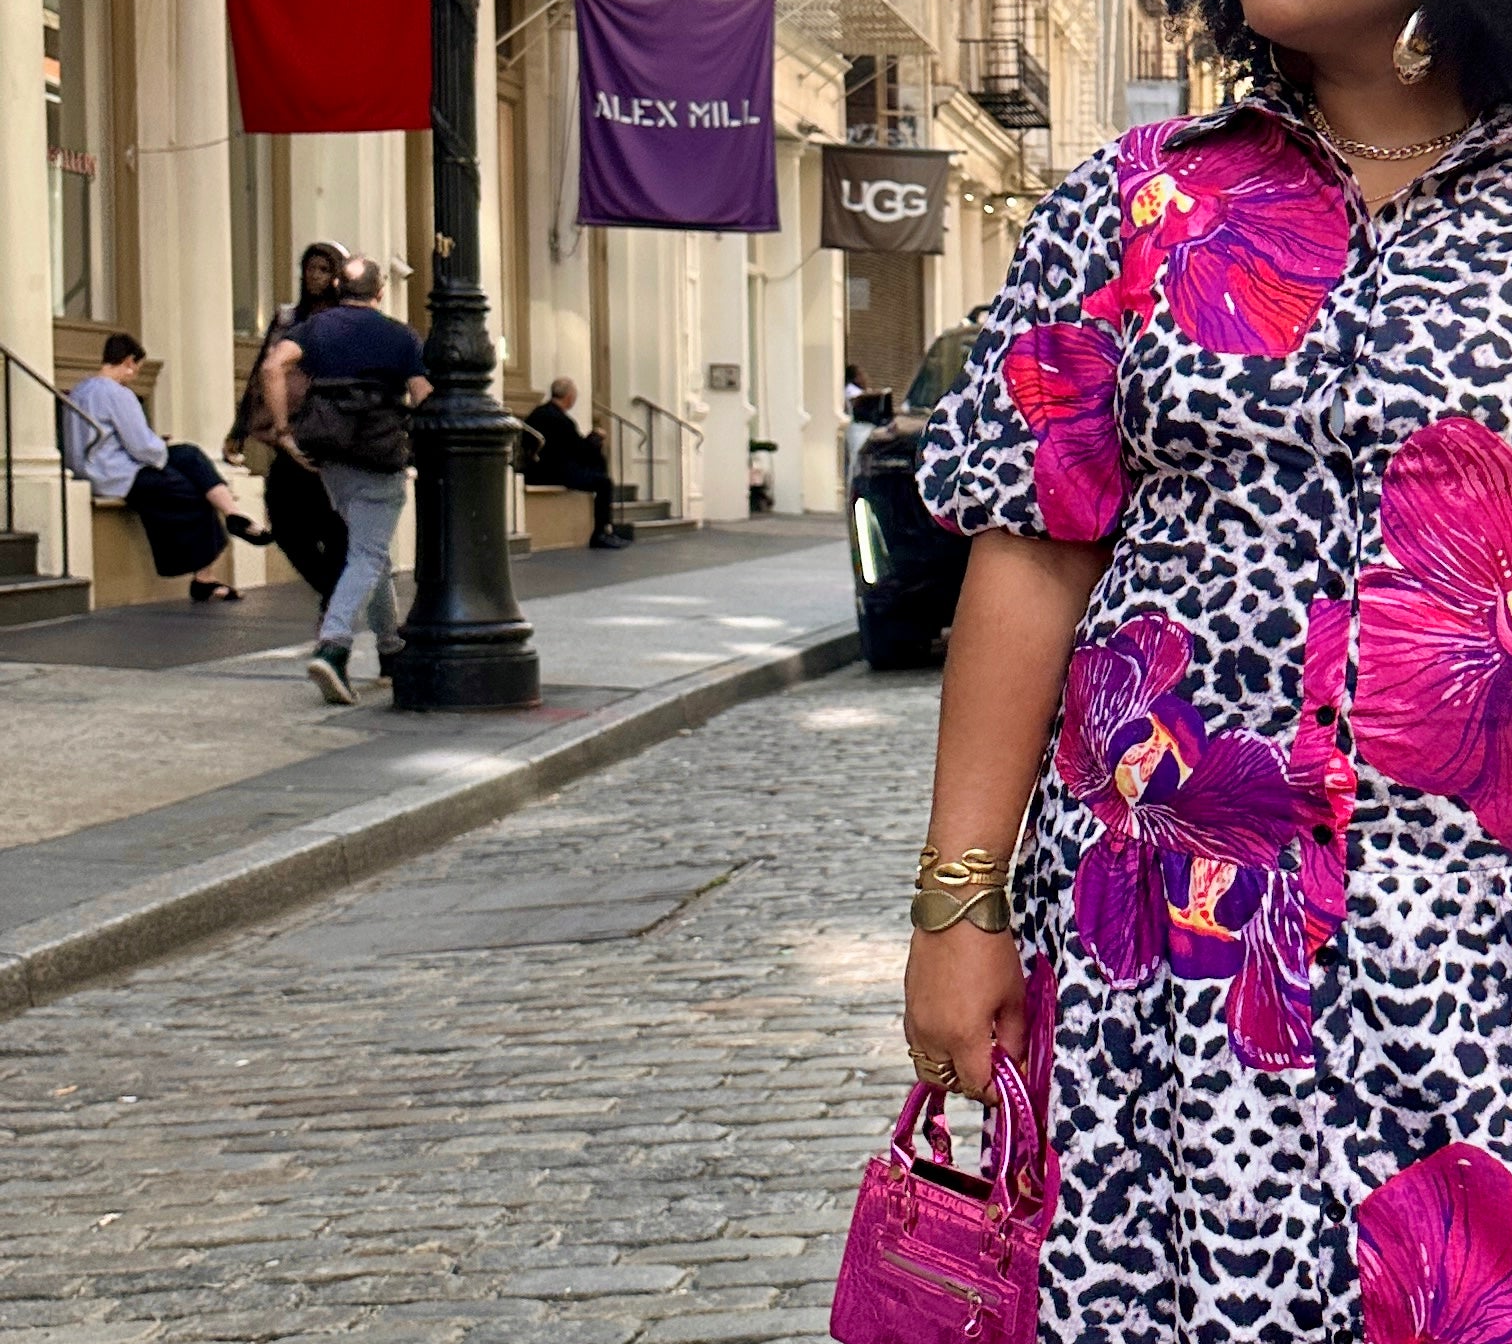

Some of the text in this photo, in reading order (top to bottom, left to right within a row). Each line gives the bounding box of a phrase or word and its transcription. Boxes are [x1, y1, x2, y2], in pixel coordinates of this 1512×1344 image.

[593, 90, 761, 129] ALEX MILL
[840, 178, 928, 223] UGG
